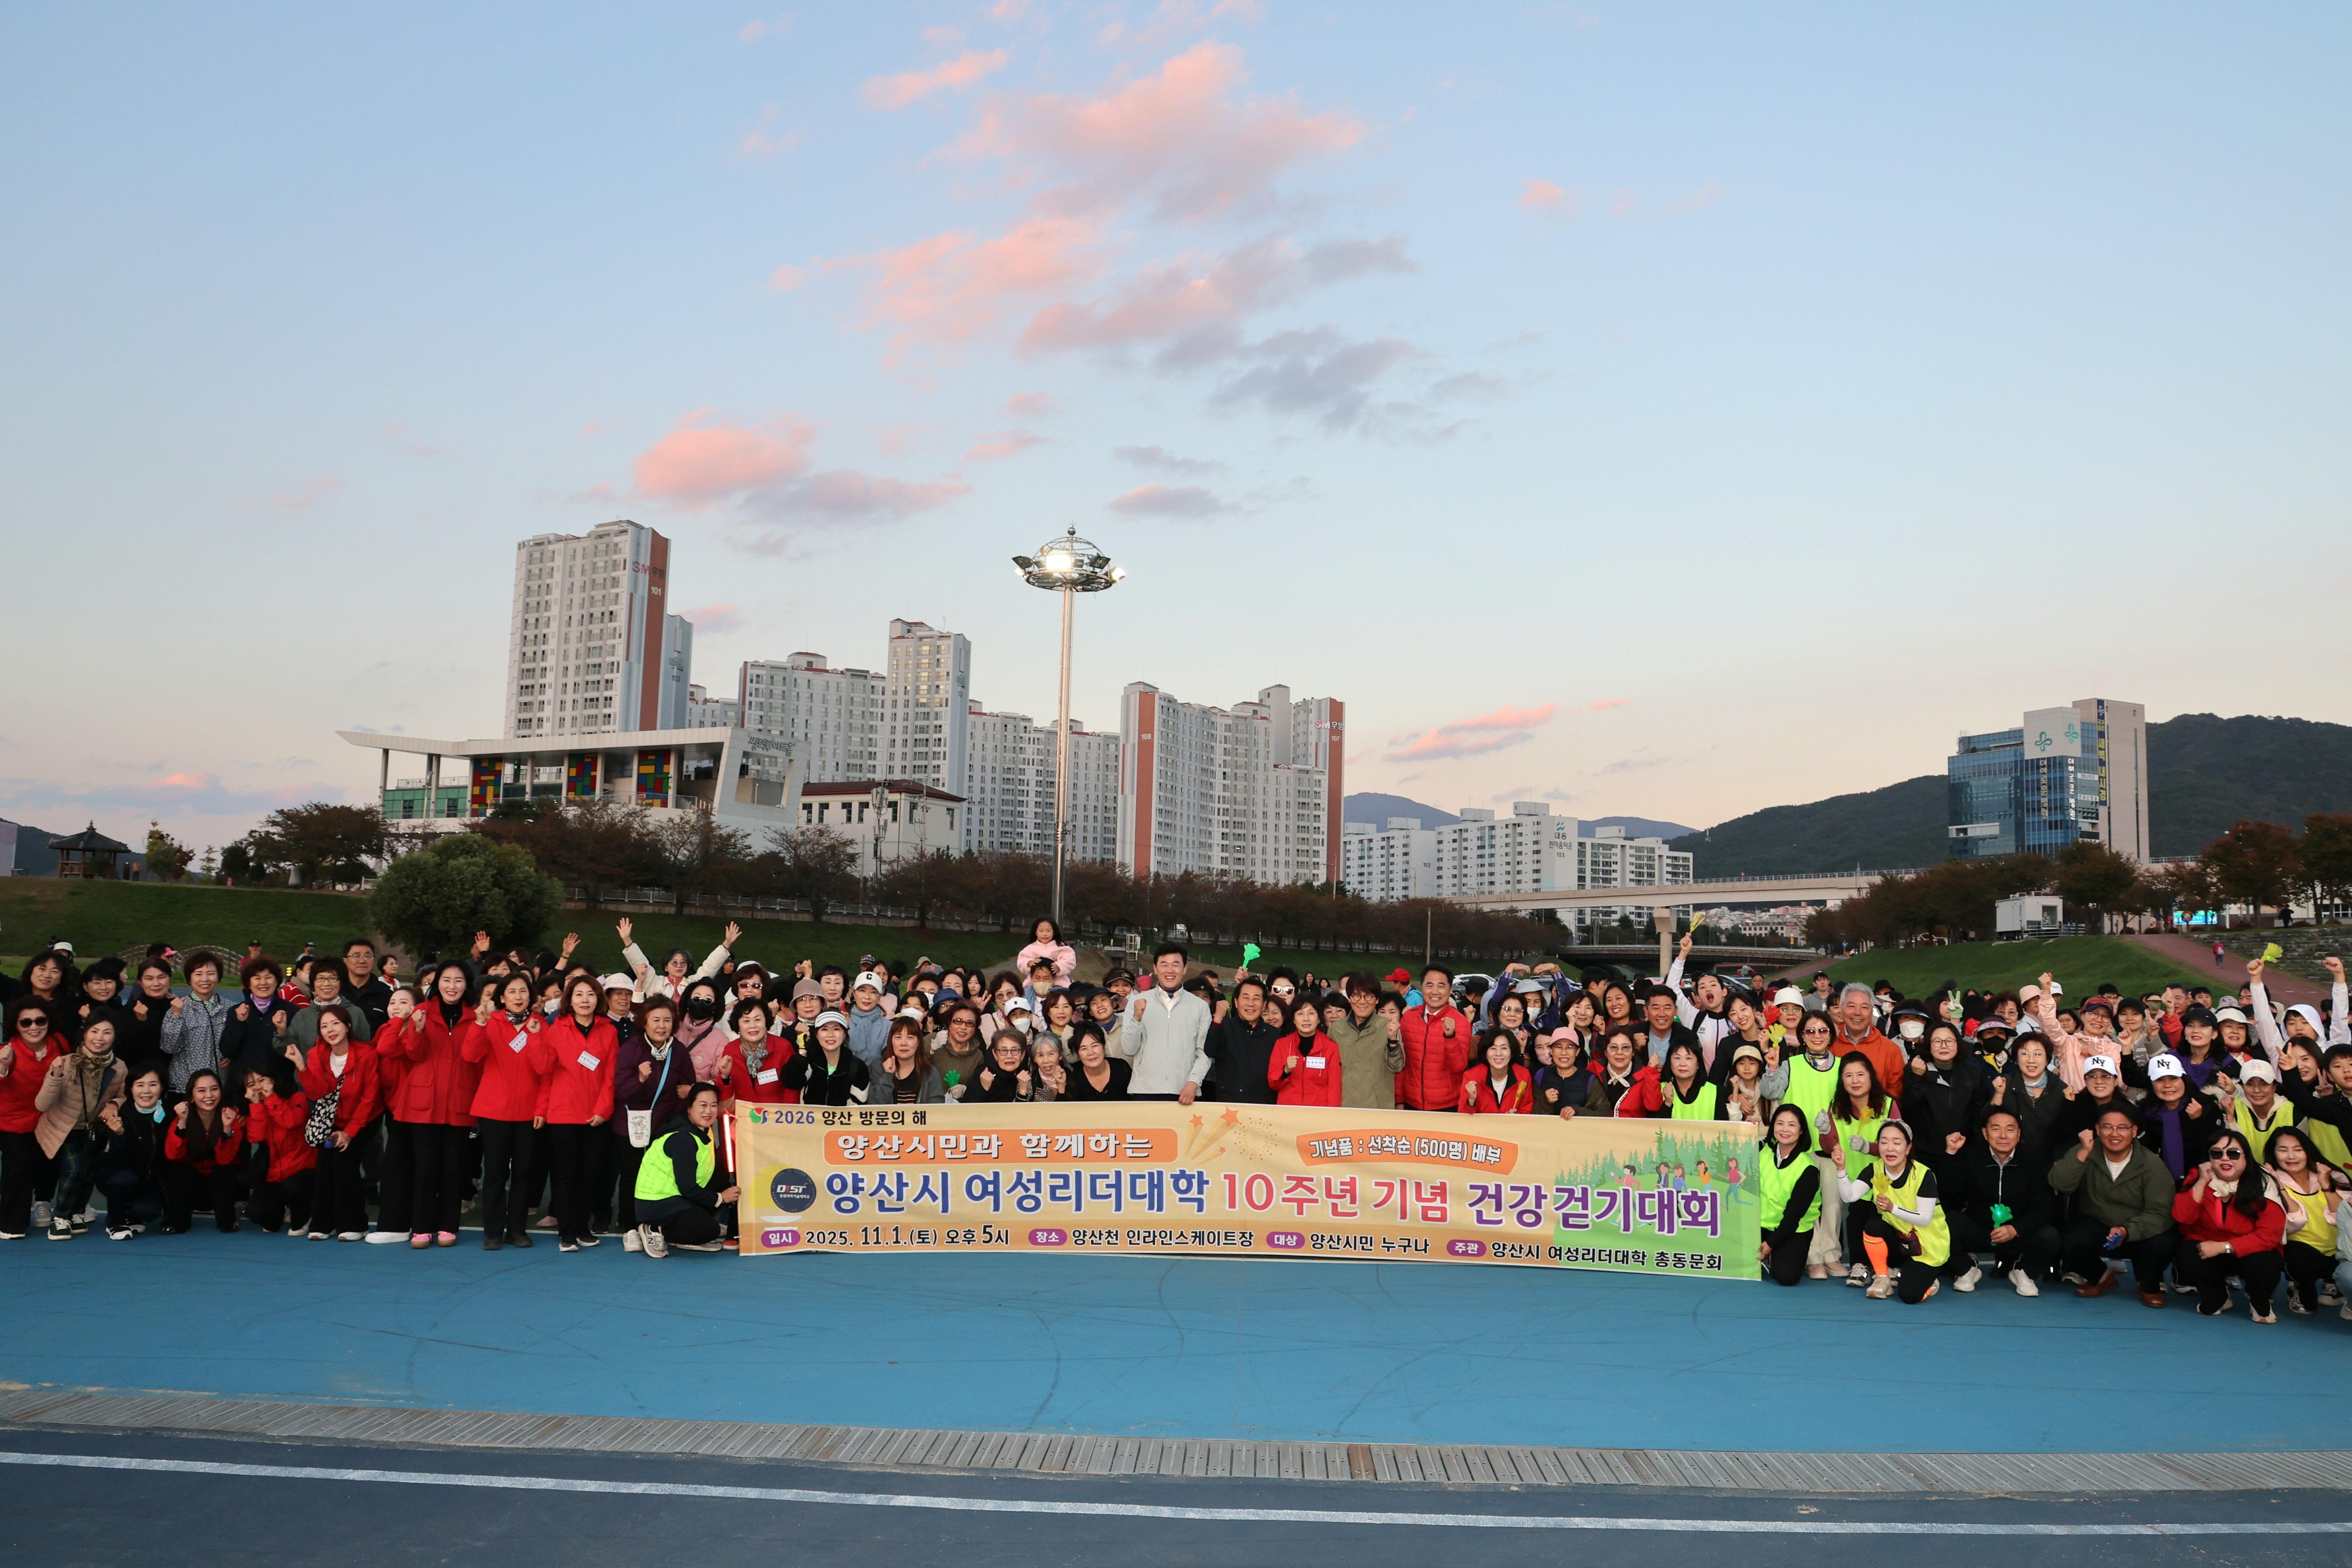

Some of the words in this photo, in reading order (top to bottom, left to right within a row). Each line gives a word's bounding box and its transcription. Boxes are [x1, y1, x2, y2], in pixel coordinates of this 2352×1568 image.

[651, 586, 661, 596] 101
[1549, 841, 1572, 850] 한마음타운
[2092, 1057, 2106, 1067] NY
[2157, 1059, 2171, 1069] NY
[775, 1110, 815, 1124] 2026
[822, 1110, 852, 1126] 양산
[859, 1110, 905, 1126] 방문의
[912, 1110, 927, 1126] 해
[838, 1135, 1002, 1160] 양산시민과
[1019, 1133, 1153, 1159] 함께하는
[1309, 1137, 1353, 1158] 기념품
[1368, 1135, 1412, 1155] 선착순
[1415, 1137, 1468, 1162] (500명)
[1471, 1143, 1502, 1166] 배부
[776, 1184, 807, 1193] DIST
[825, 1170, 951, 1214] 양산시
[964, 1168, 1210, 1214] 여성리더대학
[1222, 1173, 1359, 1219] 10주년
[1371, 1177, 1449, 1223] 기념
[1466, 1182, 1721, 1238] 건강걷기대회
[768, 1233, 793, 1244] 일시
[805, 1230, 854, 1246] 2025.
[945, 1228, 977, 1245] 오후
[981, 1224, 1009, 1245] 5시
[1035, 1231, 1059, 1243] 장소
[1072, 1229, 1120, 1246] 양산천
[1126, 1229, 1254, 1247] 인라인스케이트장
[1274, 1234, 1297, 1246] 대상
[1310, 1233, 1374, 1252] 양산시민
[1380, 1237, 1430, 1254] 누구나
[1454, 1242, 1479, 1254] 주관
[1492, 1242, 1541, 1260] 양산시
[1547, 1246, 1648, 1267] 여성리더대학
[1654, 1251, 1723, 1271] 총동문회
